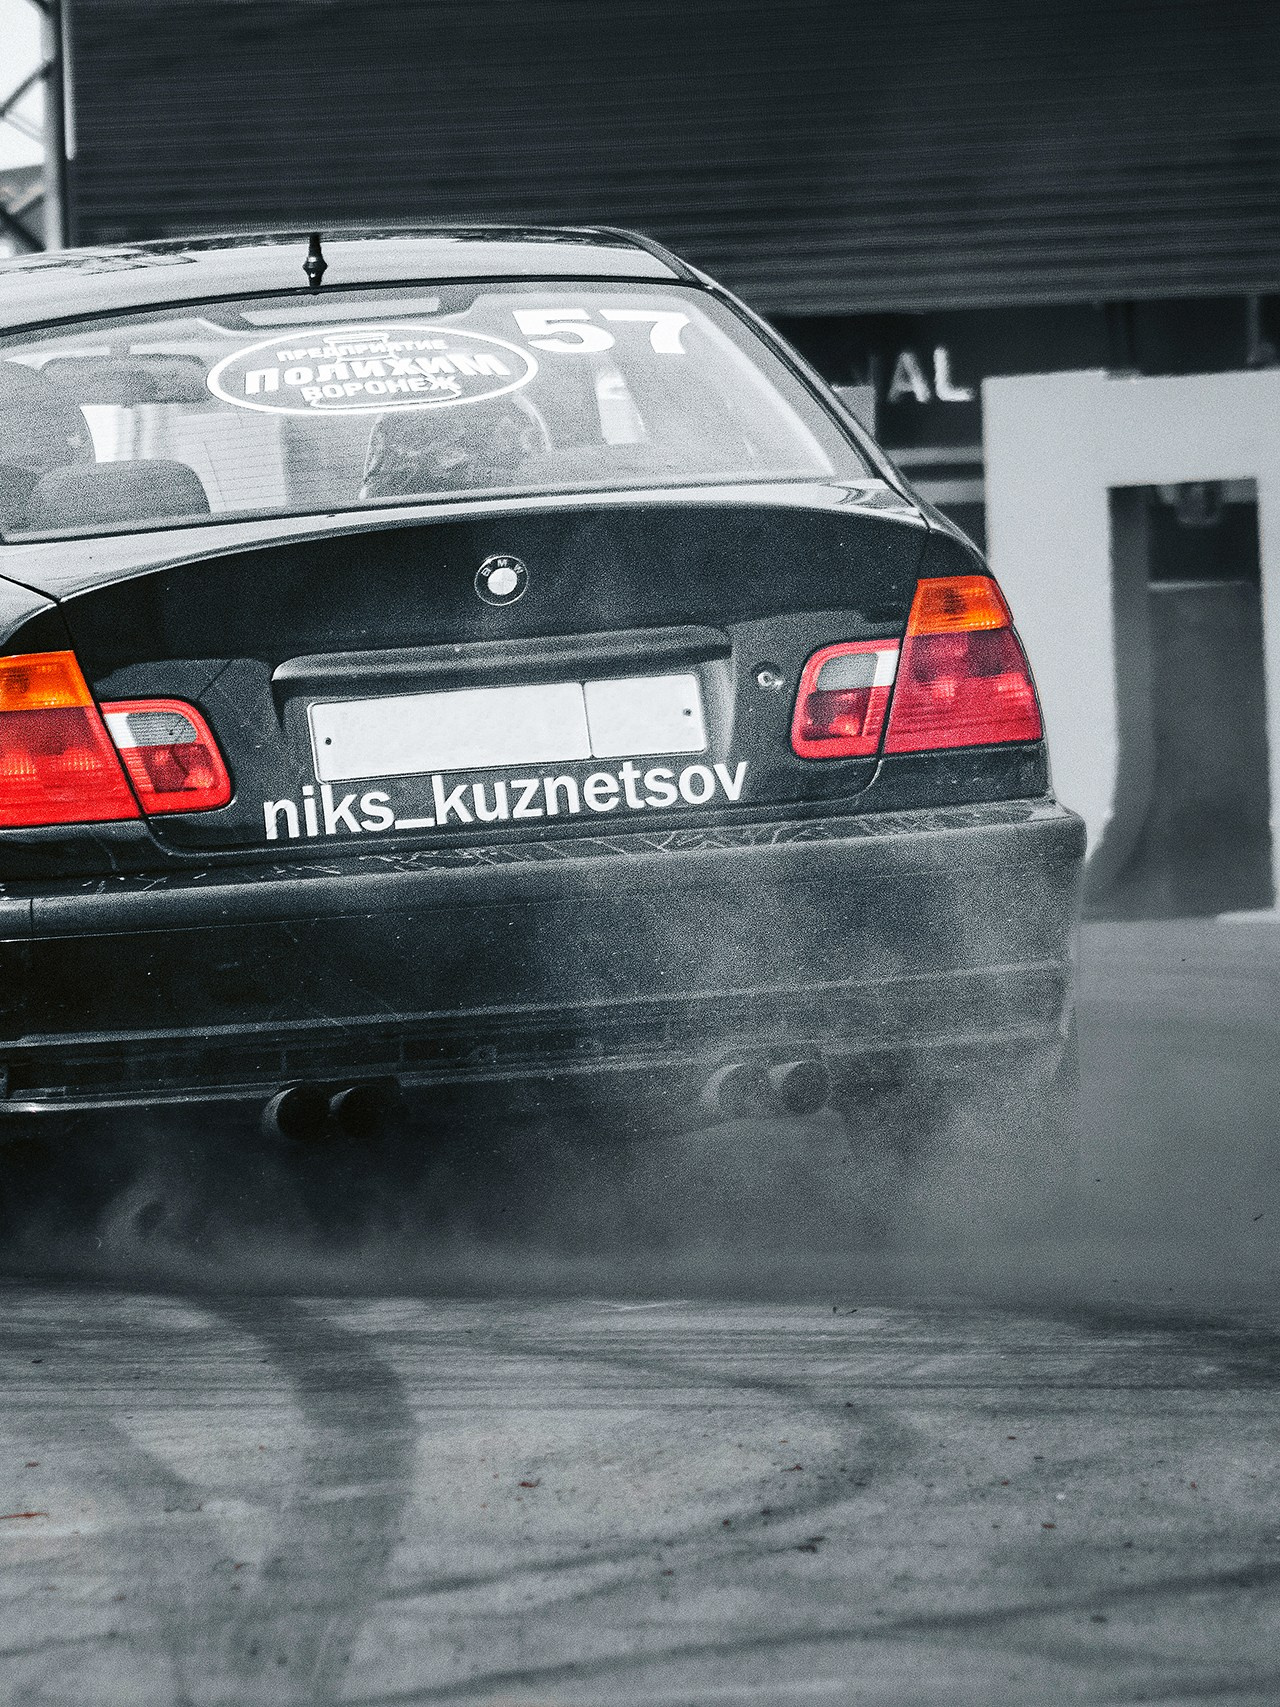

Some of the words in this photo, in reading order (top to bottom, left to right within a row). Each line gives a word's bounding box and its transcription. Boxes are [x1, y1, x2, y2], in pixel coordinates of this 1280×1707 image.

[510, 307, 692, 356] 57
[276, 338, 449, 363] ПРЕДПРИЯТИЕ
[243, 352, 512, 395] ПОЛИХИМ
[300, 373, 459, 402] ВОРОНЕЖ
[480, 558, 525, 577] BMW
[263, 760, 749, 841] niks_kuznetsov
